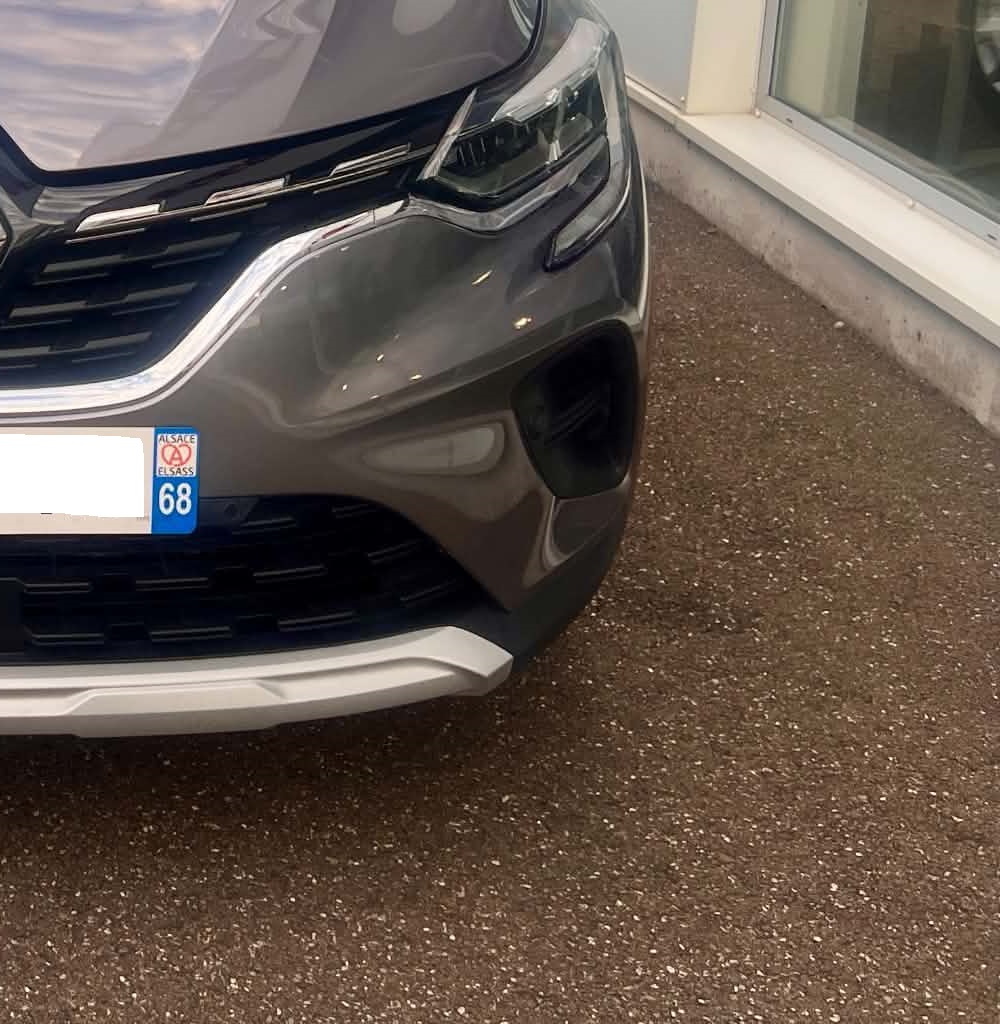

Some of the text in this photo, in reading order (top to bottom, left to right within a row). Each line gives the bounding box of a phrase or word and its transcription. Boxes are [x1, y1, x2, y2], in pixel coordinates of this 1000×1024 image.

[158, 434, 196, 444] ALSACE
[158, 467, 195, 476] ELSASS
[158, 482, 192, 515] 68
